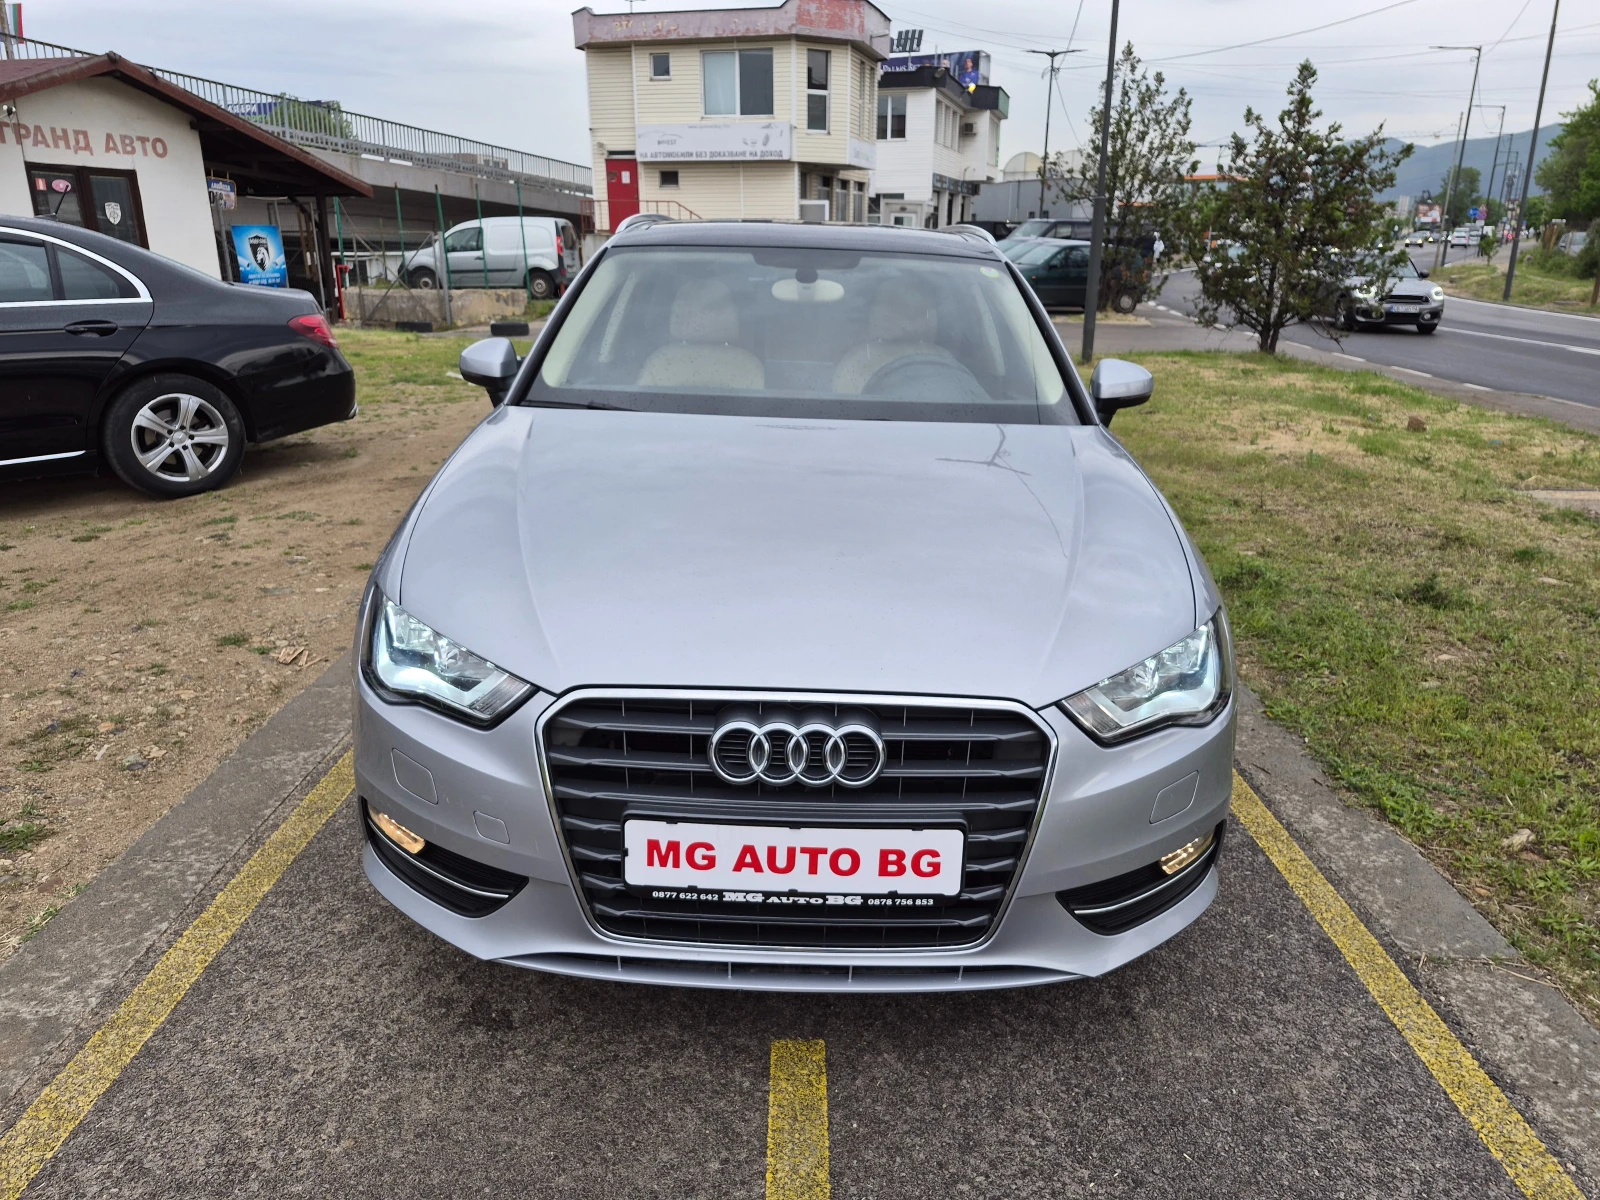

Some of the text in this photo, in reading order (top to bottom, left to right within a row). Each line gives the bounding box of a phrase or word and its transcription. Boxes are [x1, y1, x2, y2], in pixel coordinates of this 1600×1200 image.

[0, 121, 168, 159] ГРАНД АВТО
[709, 150, 747, 158] ДОКАЗВАНЕ
[759, 150, 783, 158] ДОХОД
[647, 838, 941, 878] MG AUTO BG
[652, 891, 677, 899] 0877
[679, 892, 698, 900] 622
[700, 893, 719, 901] 642
[723, 892, 765, 902] MG
[826, 895, 863, 905] BG
[895, 898, 913, 906] 756
